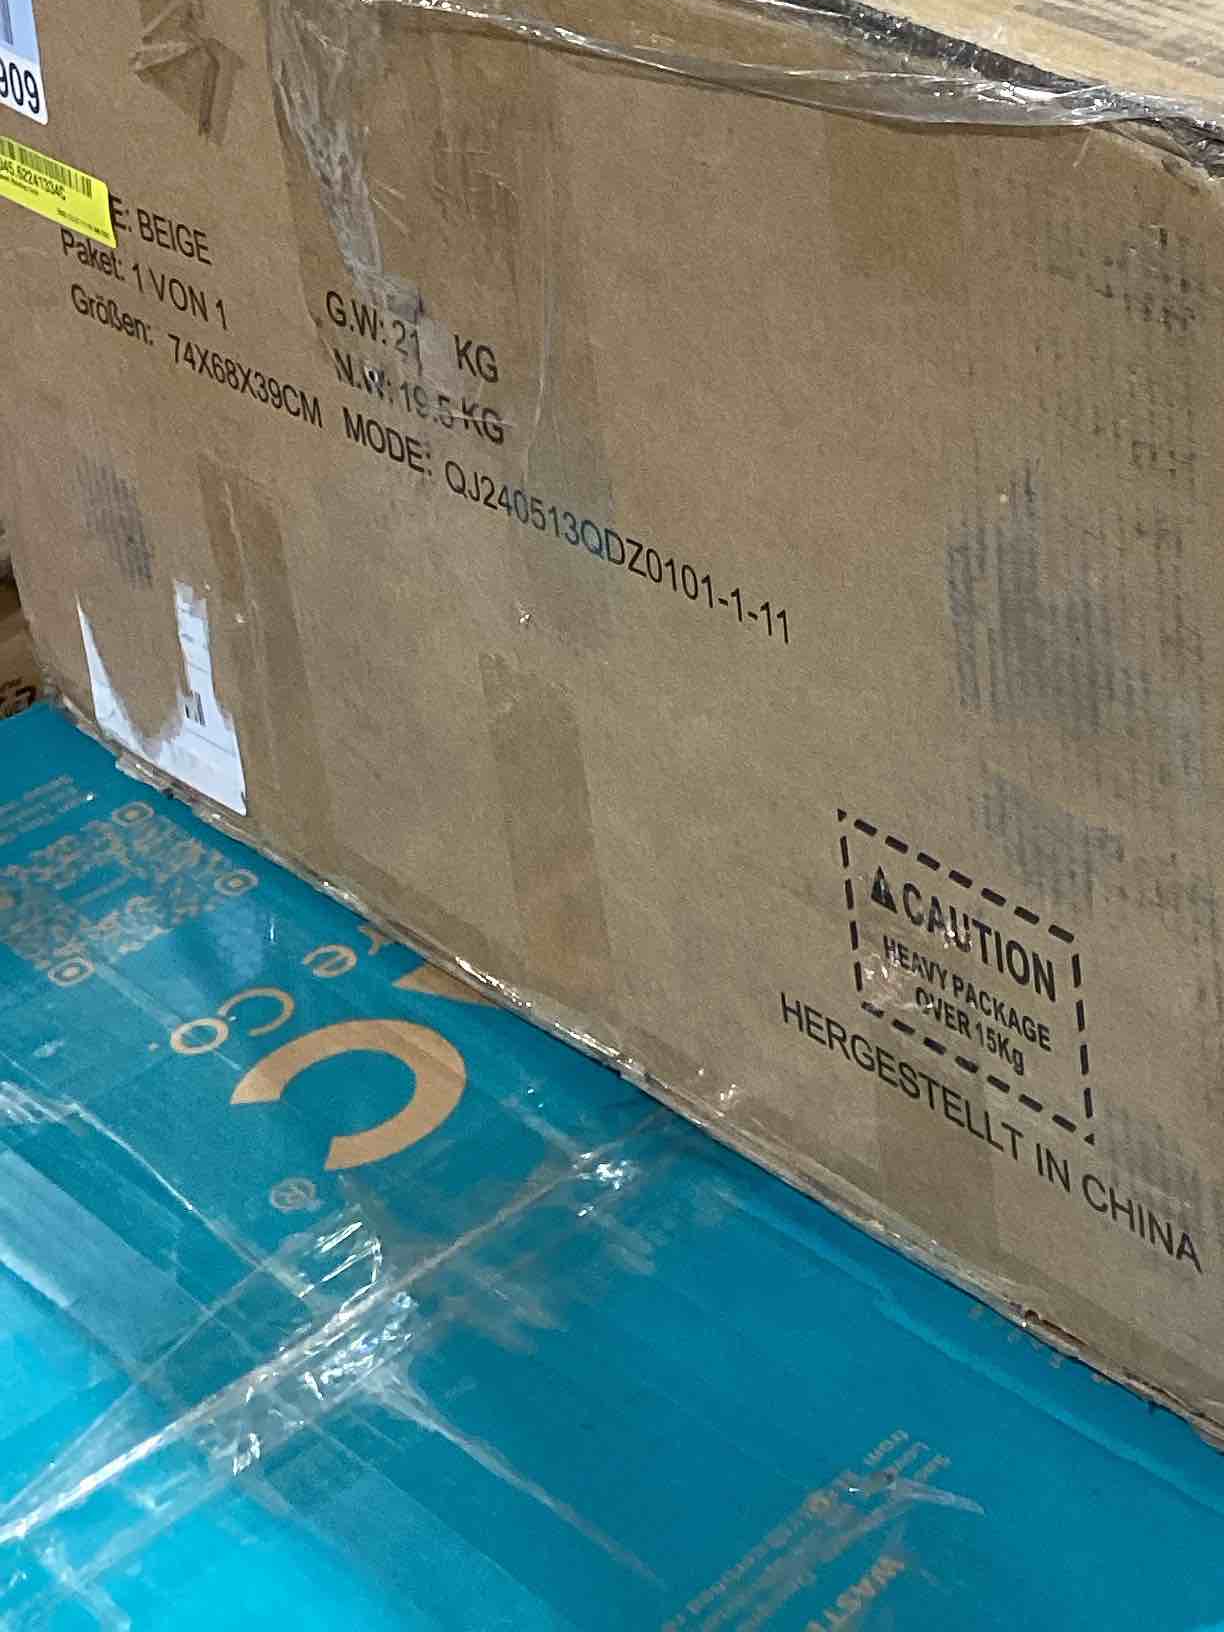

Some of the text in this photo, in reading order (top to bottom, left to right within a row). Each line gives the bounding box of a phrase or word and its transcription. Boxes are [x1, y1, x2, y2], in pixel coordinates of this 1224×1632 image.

[60, 228, 228, 330] Paket: 1 VON 1
[137, 208, 212, 265] BEIGE
[325, 291, 387, 345] G.W:
[453, 334, 499, 384] KG
[71, 283, 791, 645] Größen: 74X68X39CM MODE: QJ240513QDZ0101-1-11
[460, 396, 505, 445] KG
[882, 935, 1052, 1052] HEAVY PACKAGE
[902, 882, 1057, 1003] CAUTION
[915, 986, 1026, 1076] OVER 15Kg
[780, 991, 1204, 1274] HERGESTELLT IN CHINA
